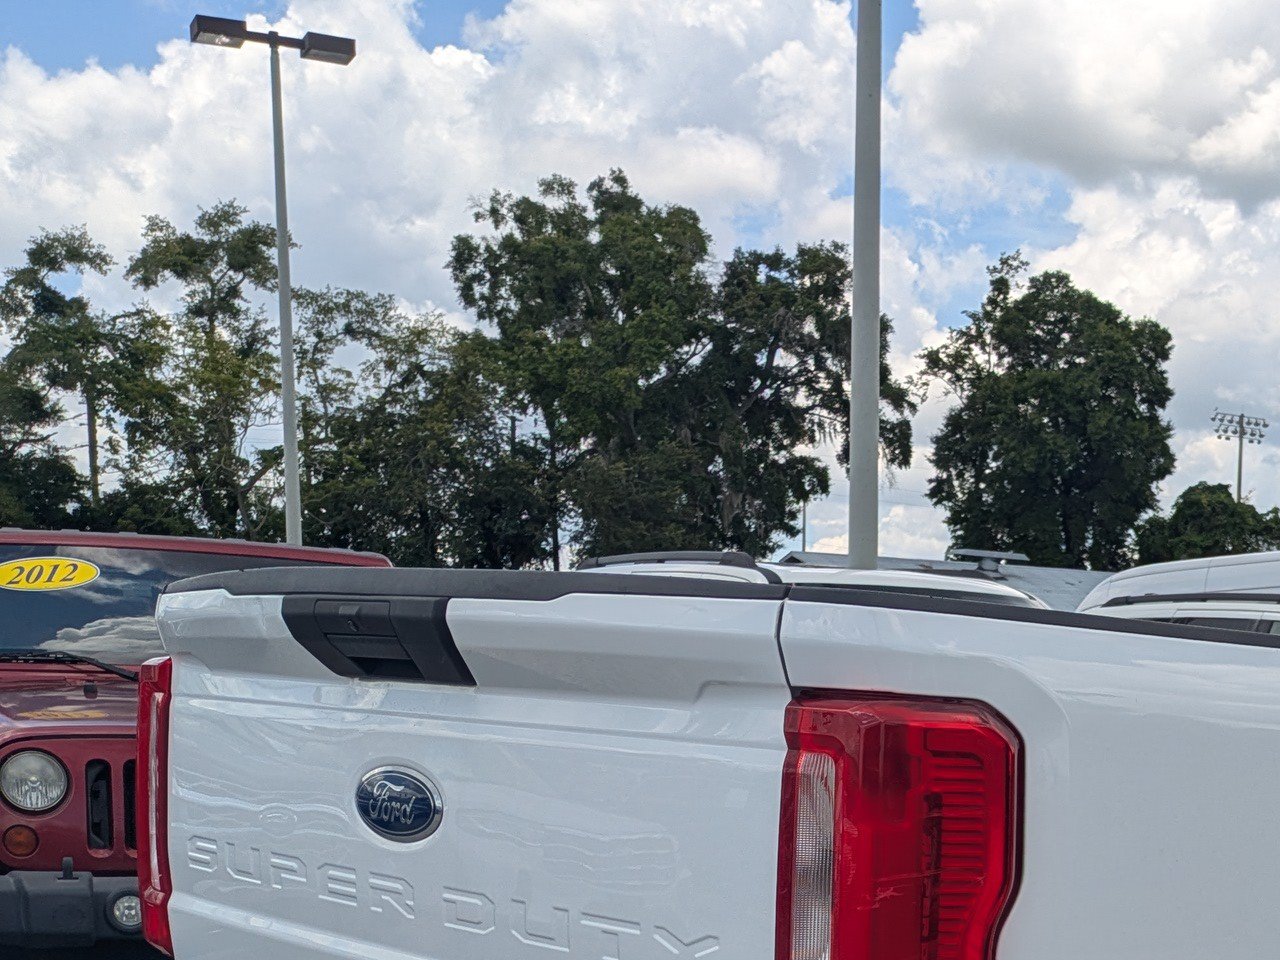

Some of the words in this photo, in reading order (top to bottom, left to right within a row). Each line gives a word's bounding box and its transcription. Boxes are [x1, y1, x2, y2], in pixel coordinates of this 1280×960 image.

[6, 563, 79, 585] 2012
[369, 780, 416, 825] Ford
[187, 835, 415, 919] SUPER
